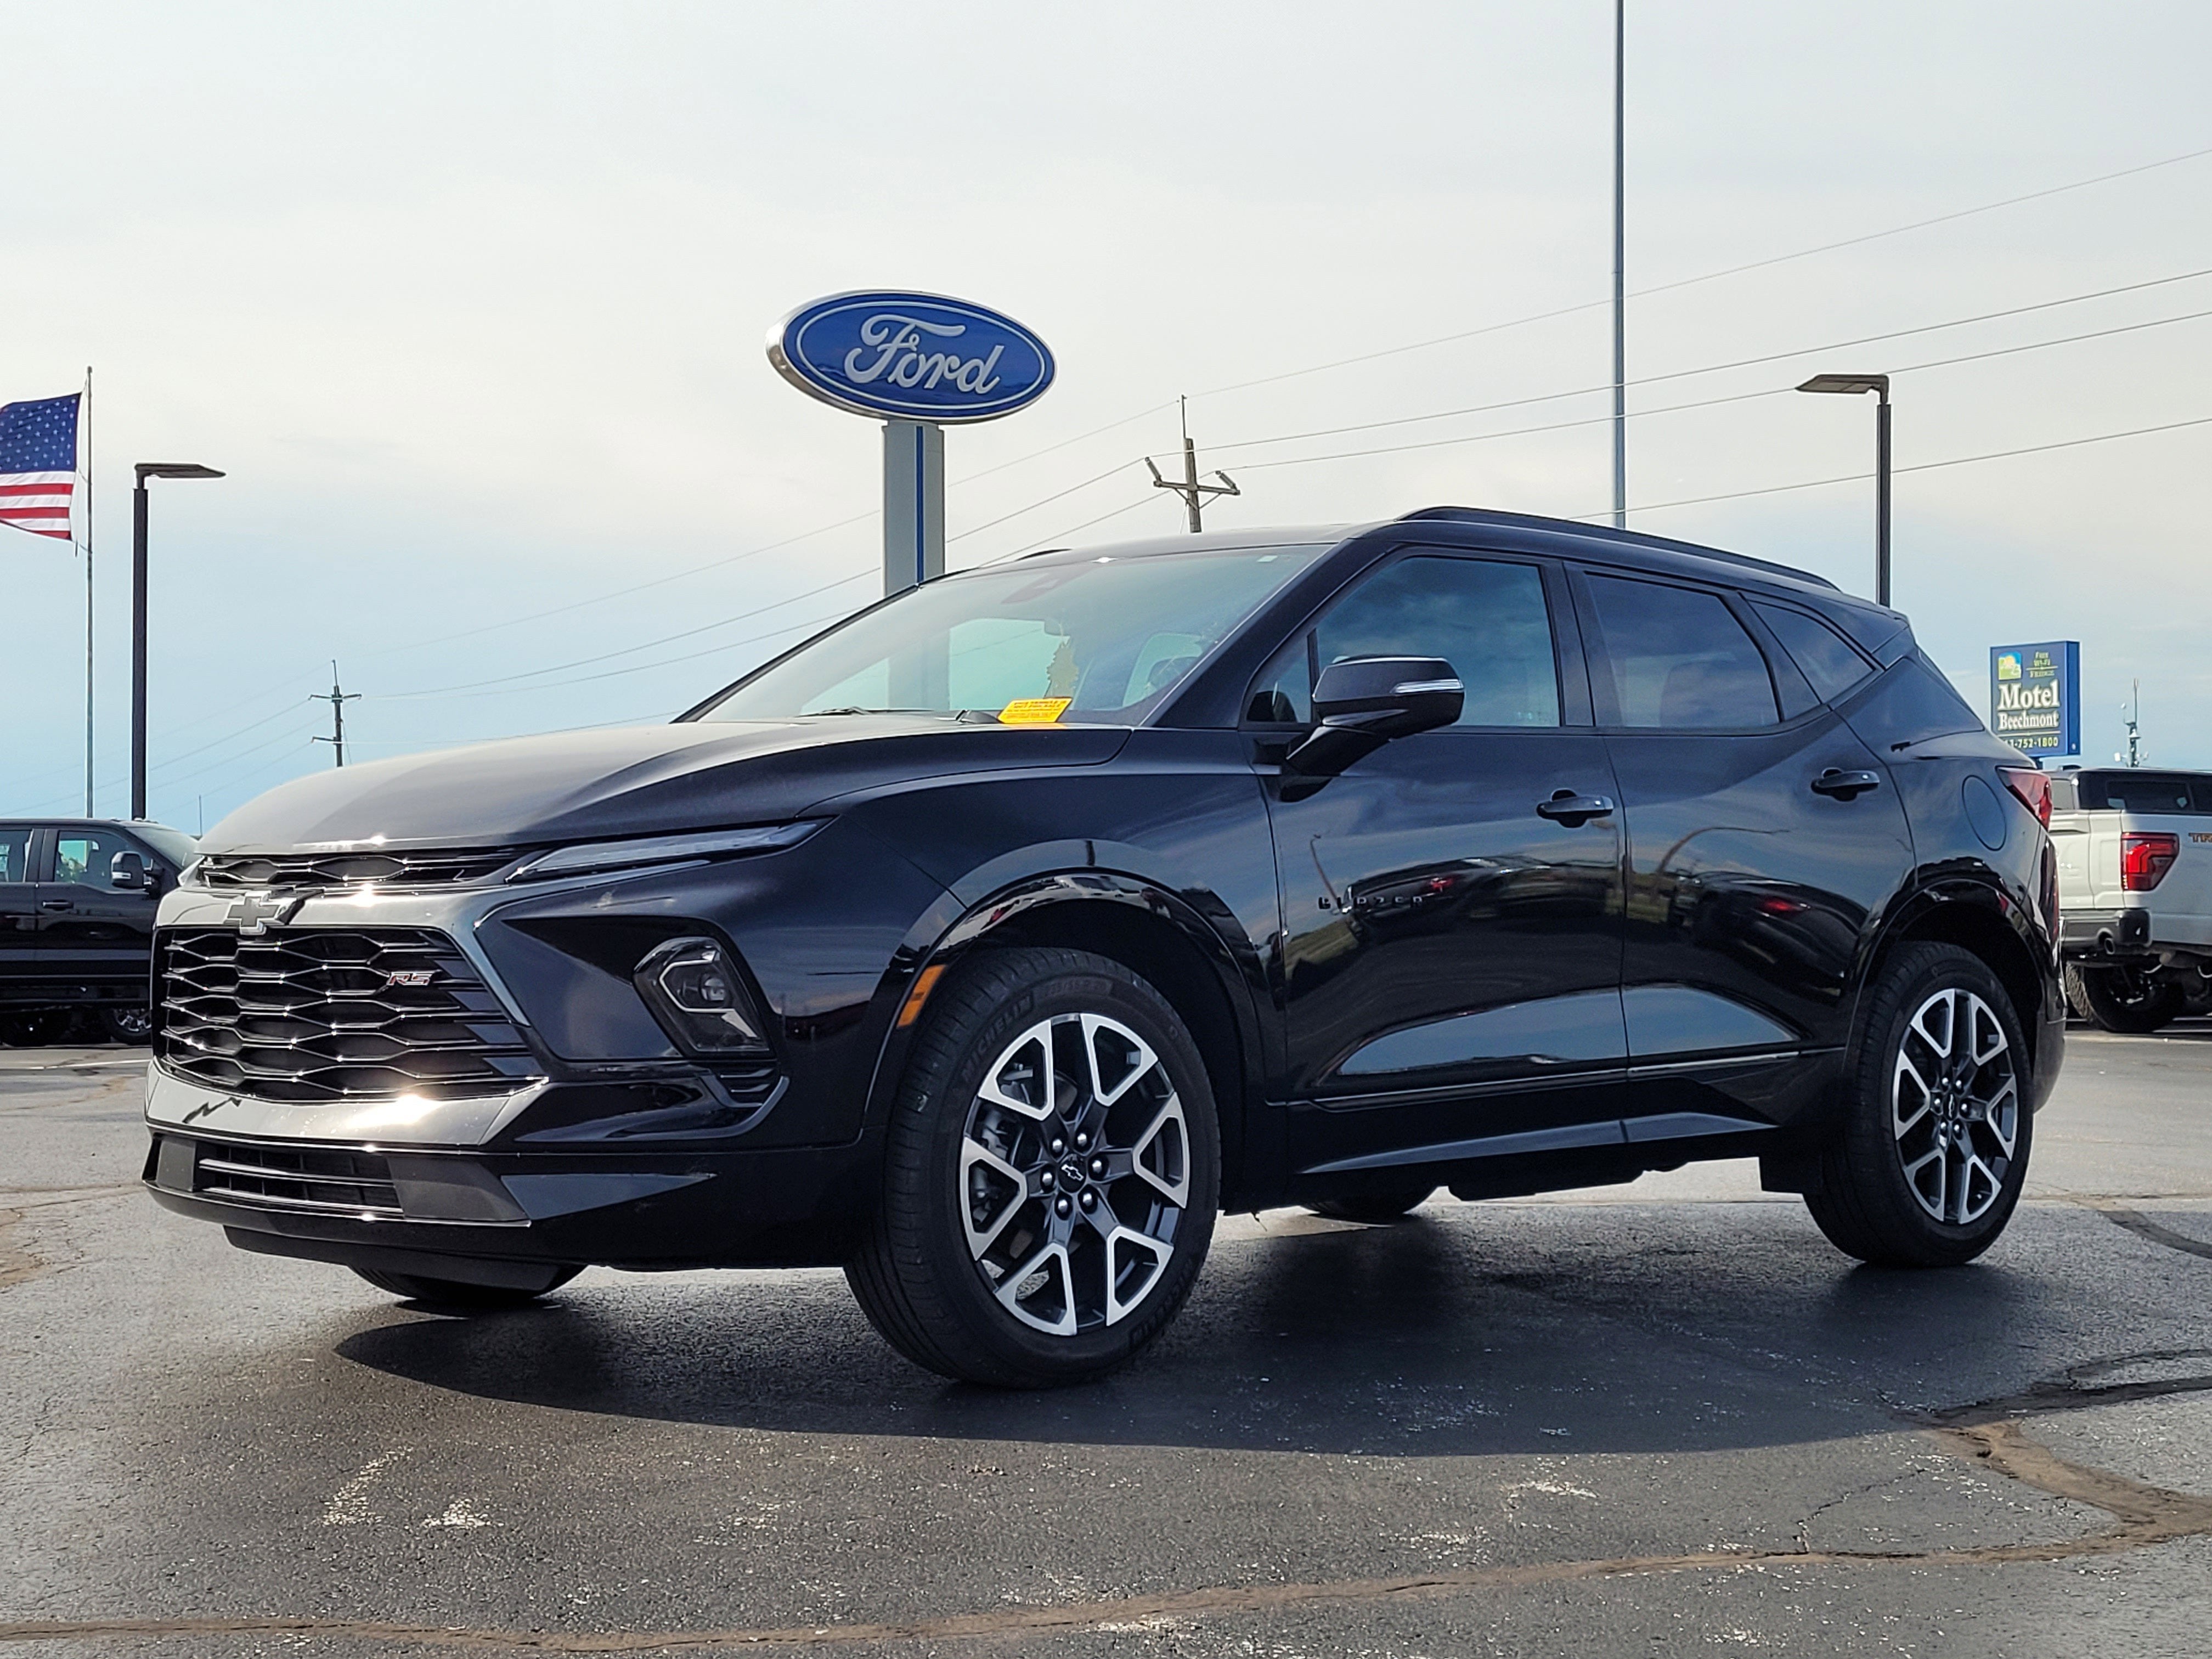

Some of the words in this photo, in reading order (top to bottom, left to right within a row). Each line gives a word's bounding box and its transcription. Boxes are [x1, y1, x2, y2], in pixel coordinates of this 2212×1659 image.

[844, 314, 1004, 394] Ford
[1997, 679, 2060, 710] Motel
[1998, 710, 2058, 731] Beechmont
[386, 970, 433, 986] RS
